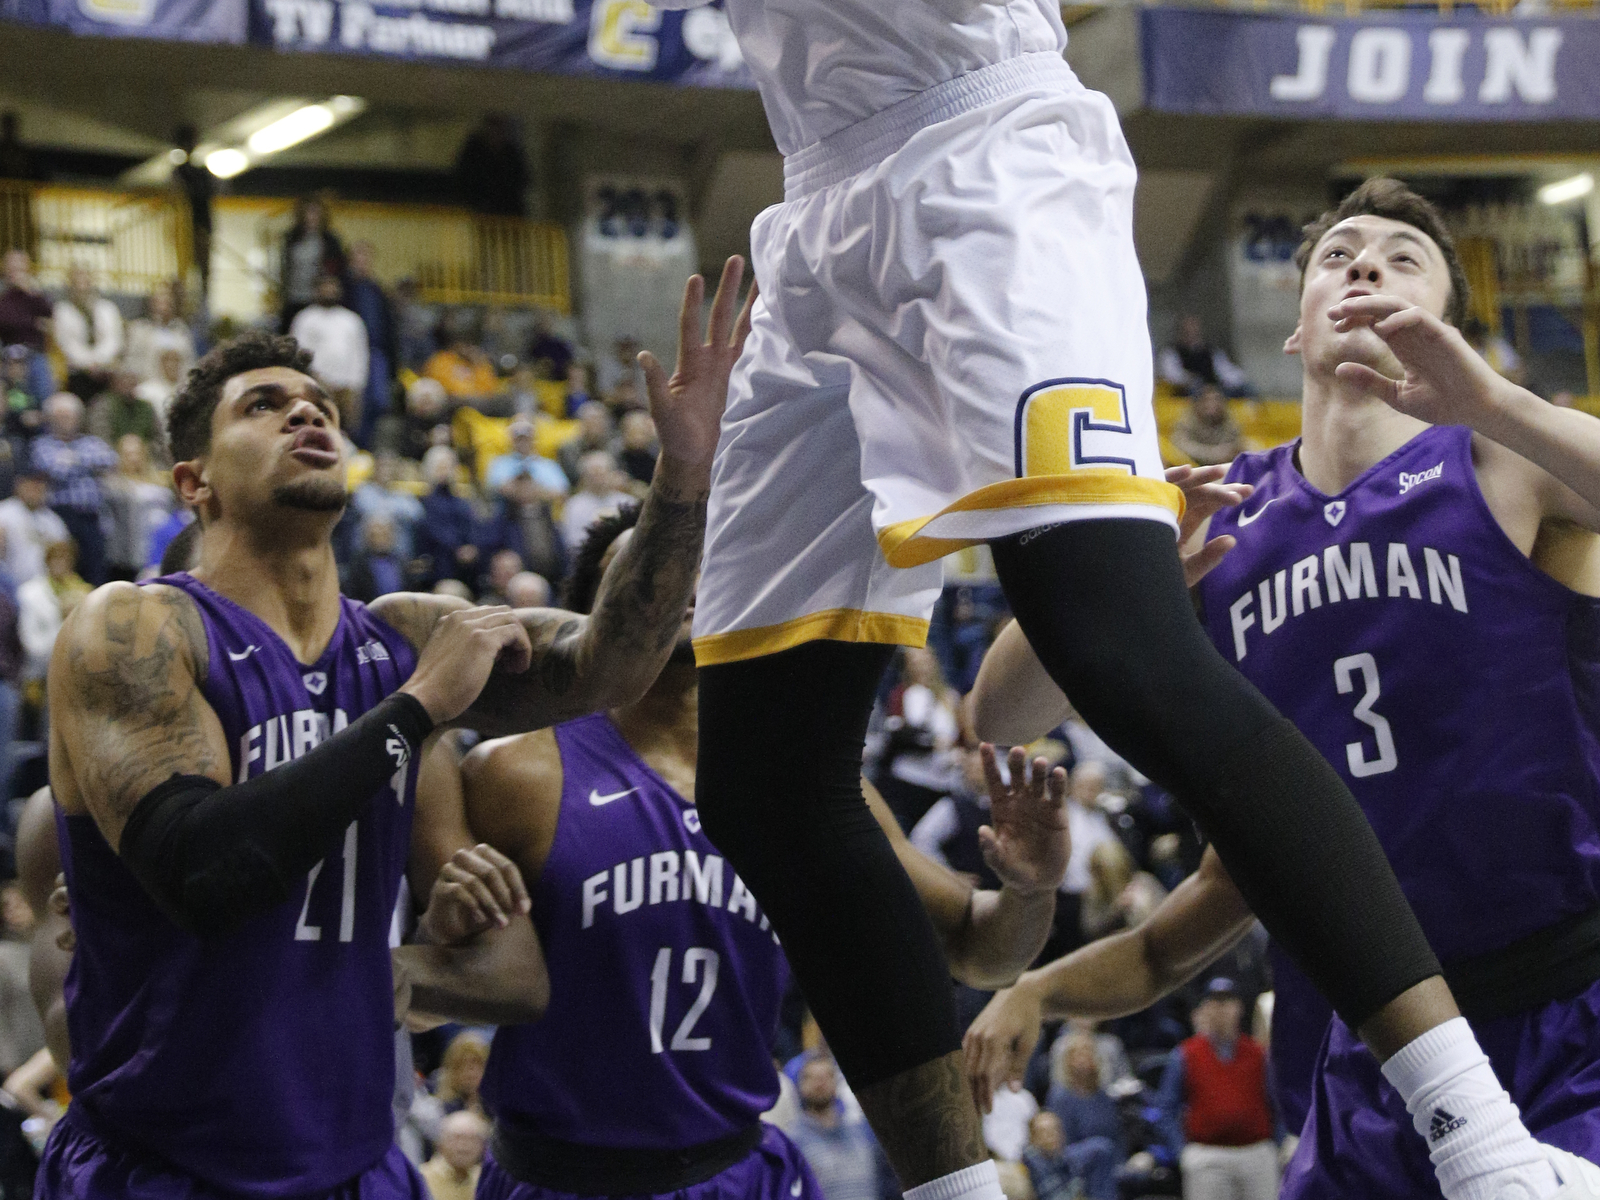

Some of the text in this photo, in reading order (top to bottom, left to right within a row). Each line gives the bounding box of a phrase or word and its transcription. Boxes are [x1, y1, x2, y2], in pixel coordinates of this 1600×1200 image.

[1269, 23, 1565, 104] JOIN
[1229, 542, 1469, 662] FURMAN
[1333, 652, 1398, 778] 3
[581, 849, 780, 945] FURMA
[650, 947, 720, 1054] 12
